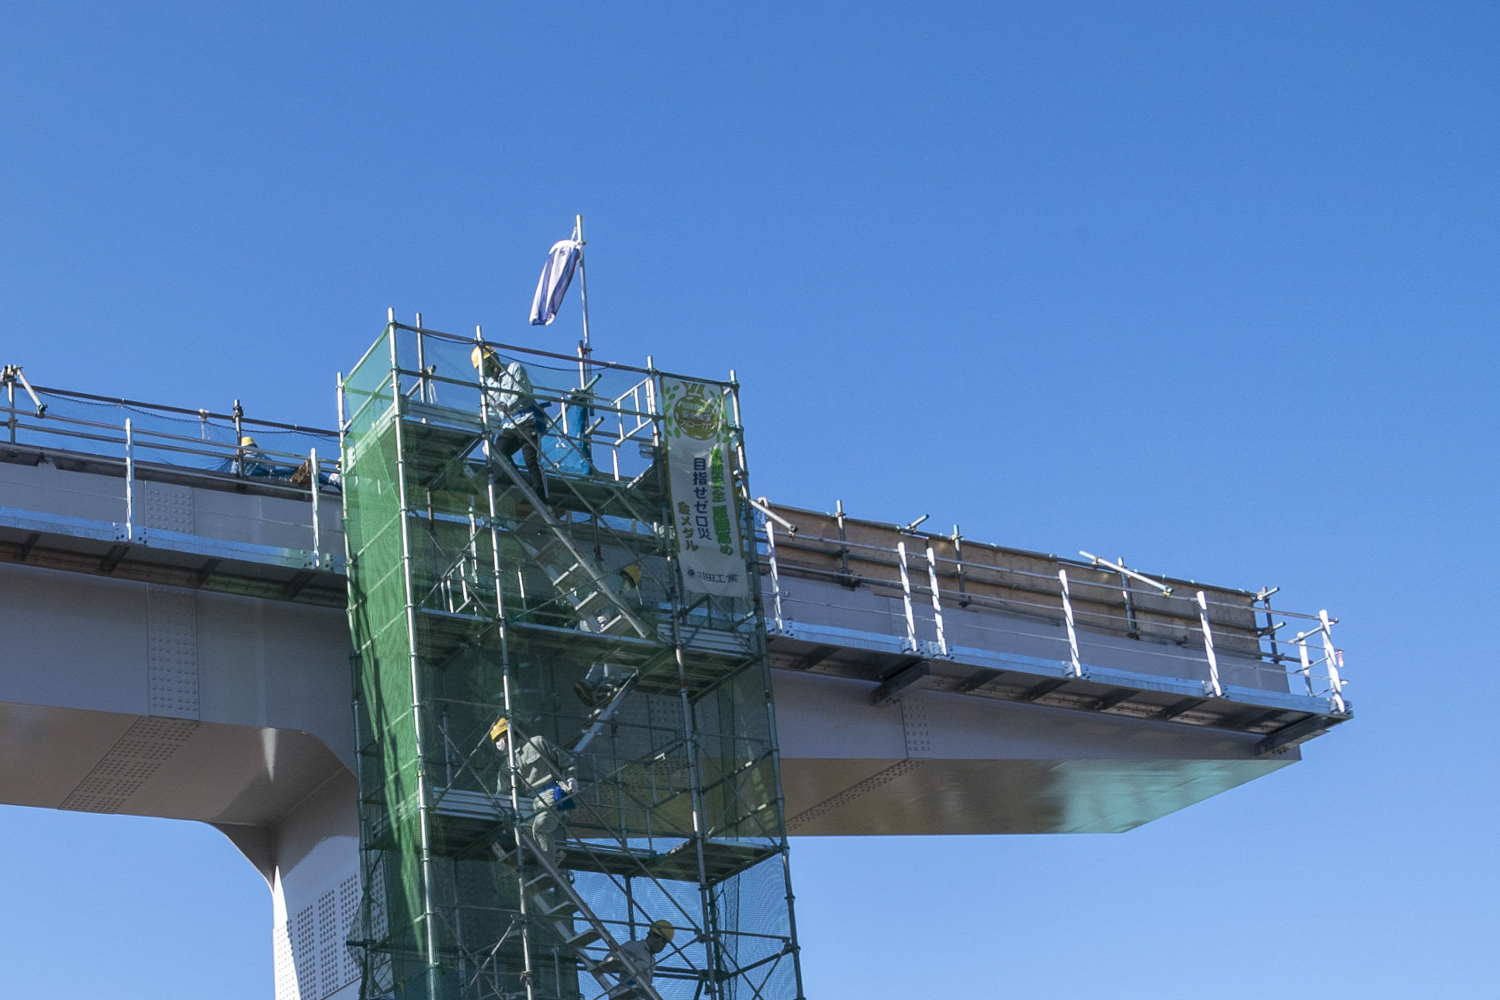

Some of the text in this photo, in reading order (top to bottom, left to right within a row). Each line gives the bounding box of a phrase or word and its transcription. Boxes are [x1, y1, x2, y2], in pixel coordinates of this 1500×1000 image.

[677, 501, 699, 552] 金メダル
[693, 457, 712, 541] 目指せゼロ災
